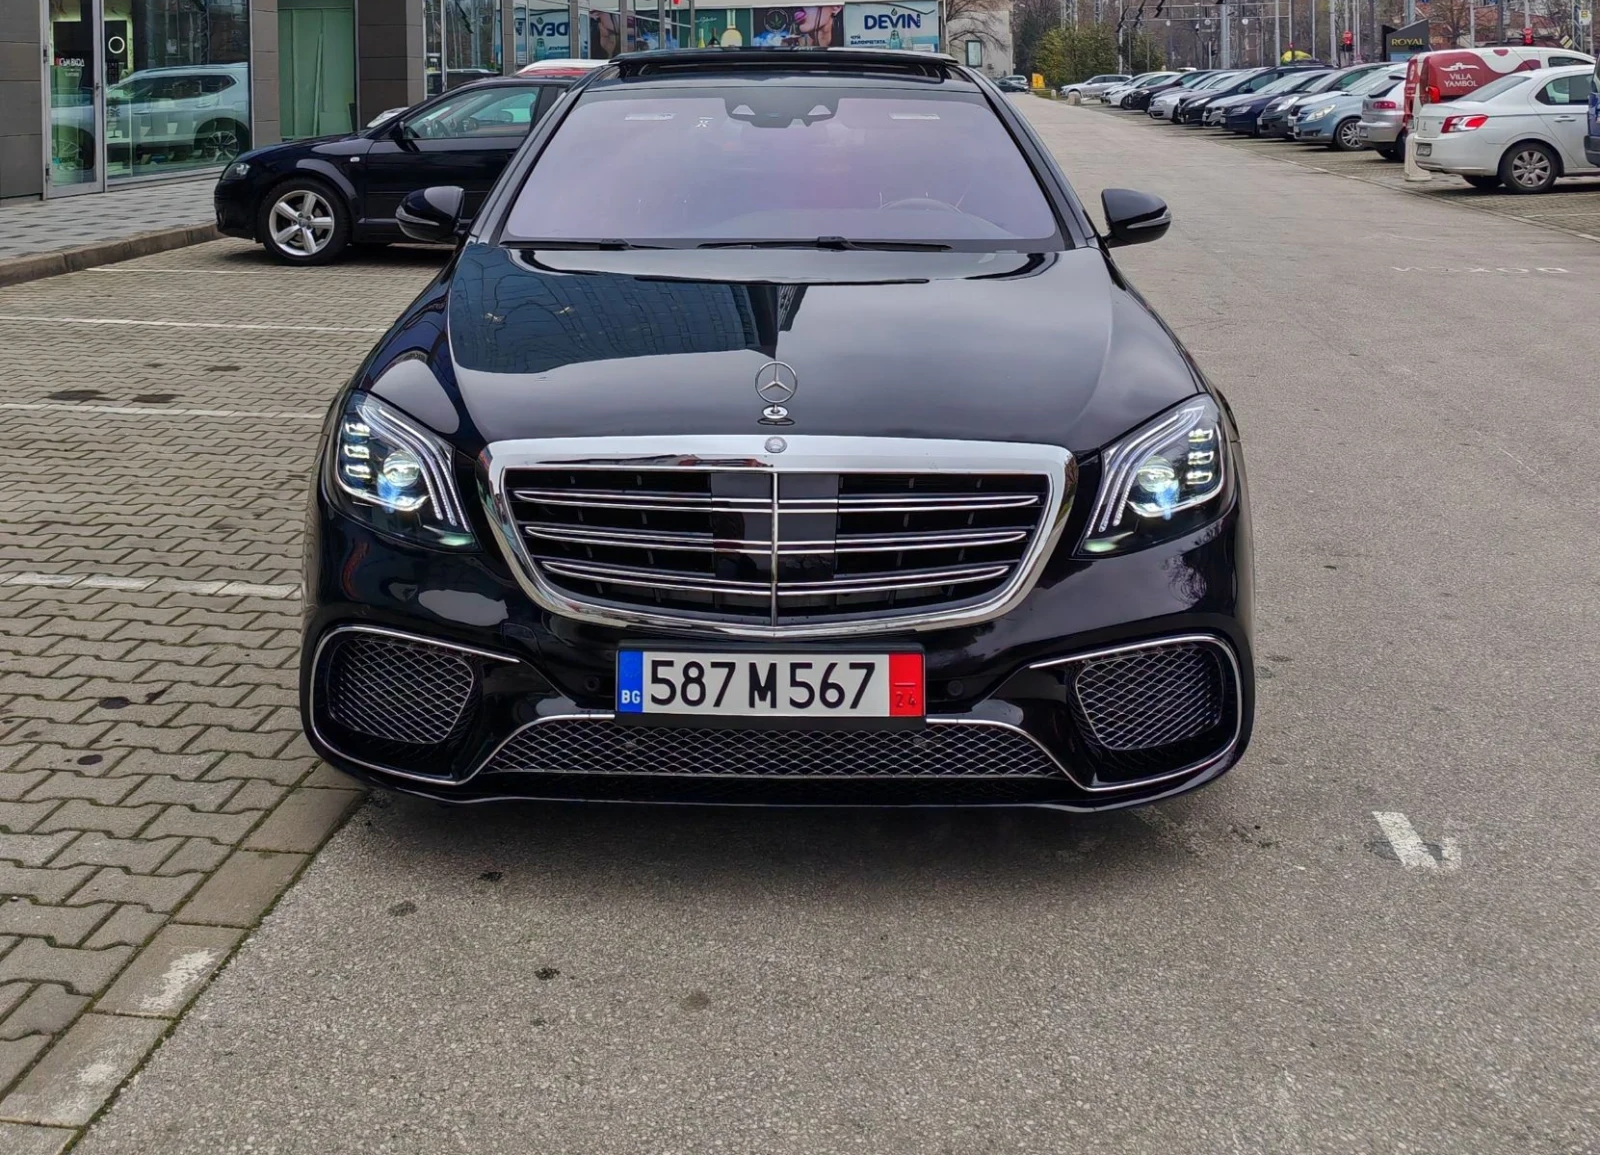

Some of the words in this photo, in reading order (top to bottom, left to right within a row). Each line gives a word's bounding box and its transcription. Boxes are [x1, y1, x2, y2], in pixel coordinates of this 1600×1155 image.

[864, 13, 921, 30] DEVIN
[1391, 38, 1423, 46] ROYAL
[1444, 80, 1478, 88] YAMBOL
[650, 659, 737, 708] 587
[748, 662, 777, 709] M
[788, 661, 876, 710] 567
[621, 690, 641, 704] BG
